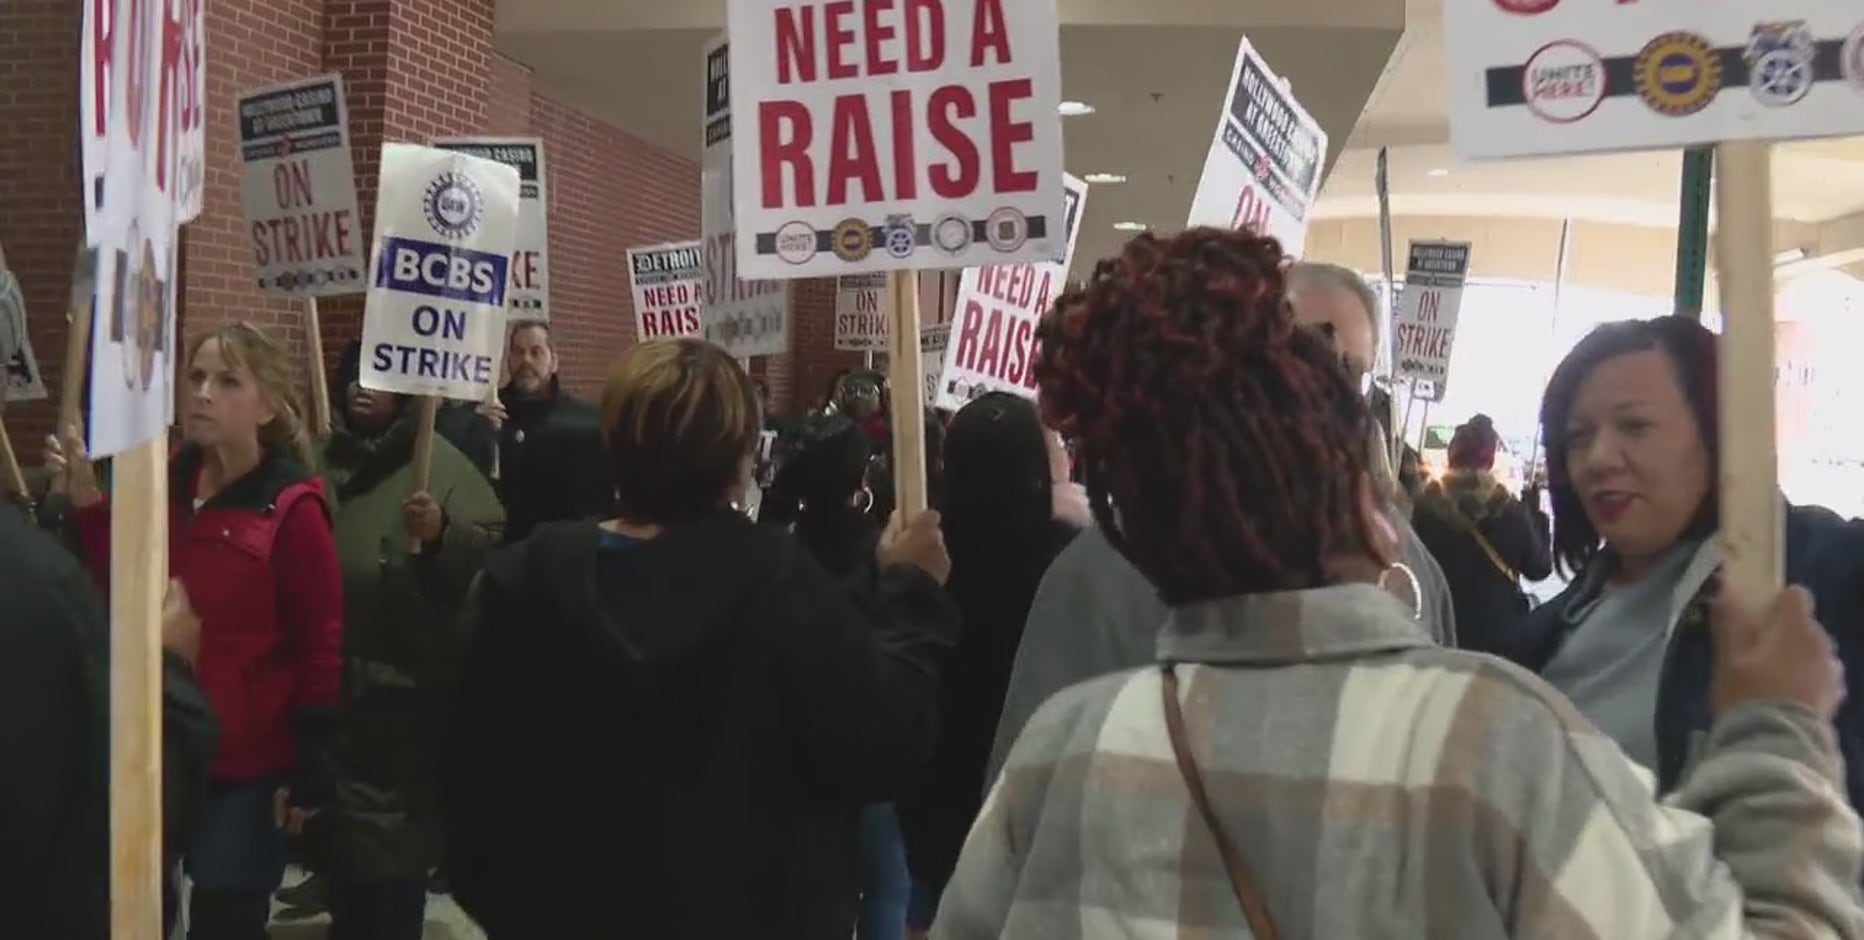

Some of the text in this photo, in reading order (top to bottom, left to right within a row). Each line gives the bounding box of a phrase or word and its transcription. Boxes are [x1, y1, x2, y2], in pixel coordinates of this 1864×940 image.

[775, 0, 1011, 84] NEED A
[759, 78, 1038, 208] RAISE
[274, 159, 313, 210] ON
[253, 210, 354, 267] STRIKE
[393, 247, 493, 294] BCBS
[636, 249, 701, 273] DETROIT
[643, 285, 688, 308] NEED
[856, 290, 878, 313] ON
[977, 262, 1052, 315] NEED A
[1418, 289, 1441, 322] ON
[412, 305, 466, 341] ON
[642, 307, 702, 337] RAIS
[838, 313, 890, 336] STRIK
[1398, 322, 1452, 359] STRIKE
[373, 343, 492, 384] STRIKE
